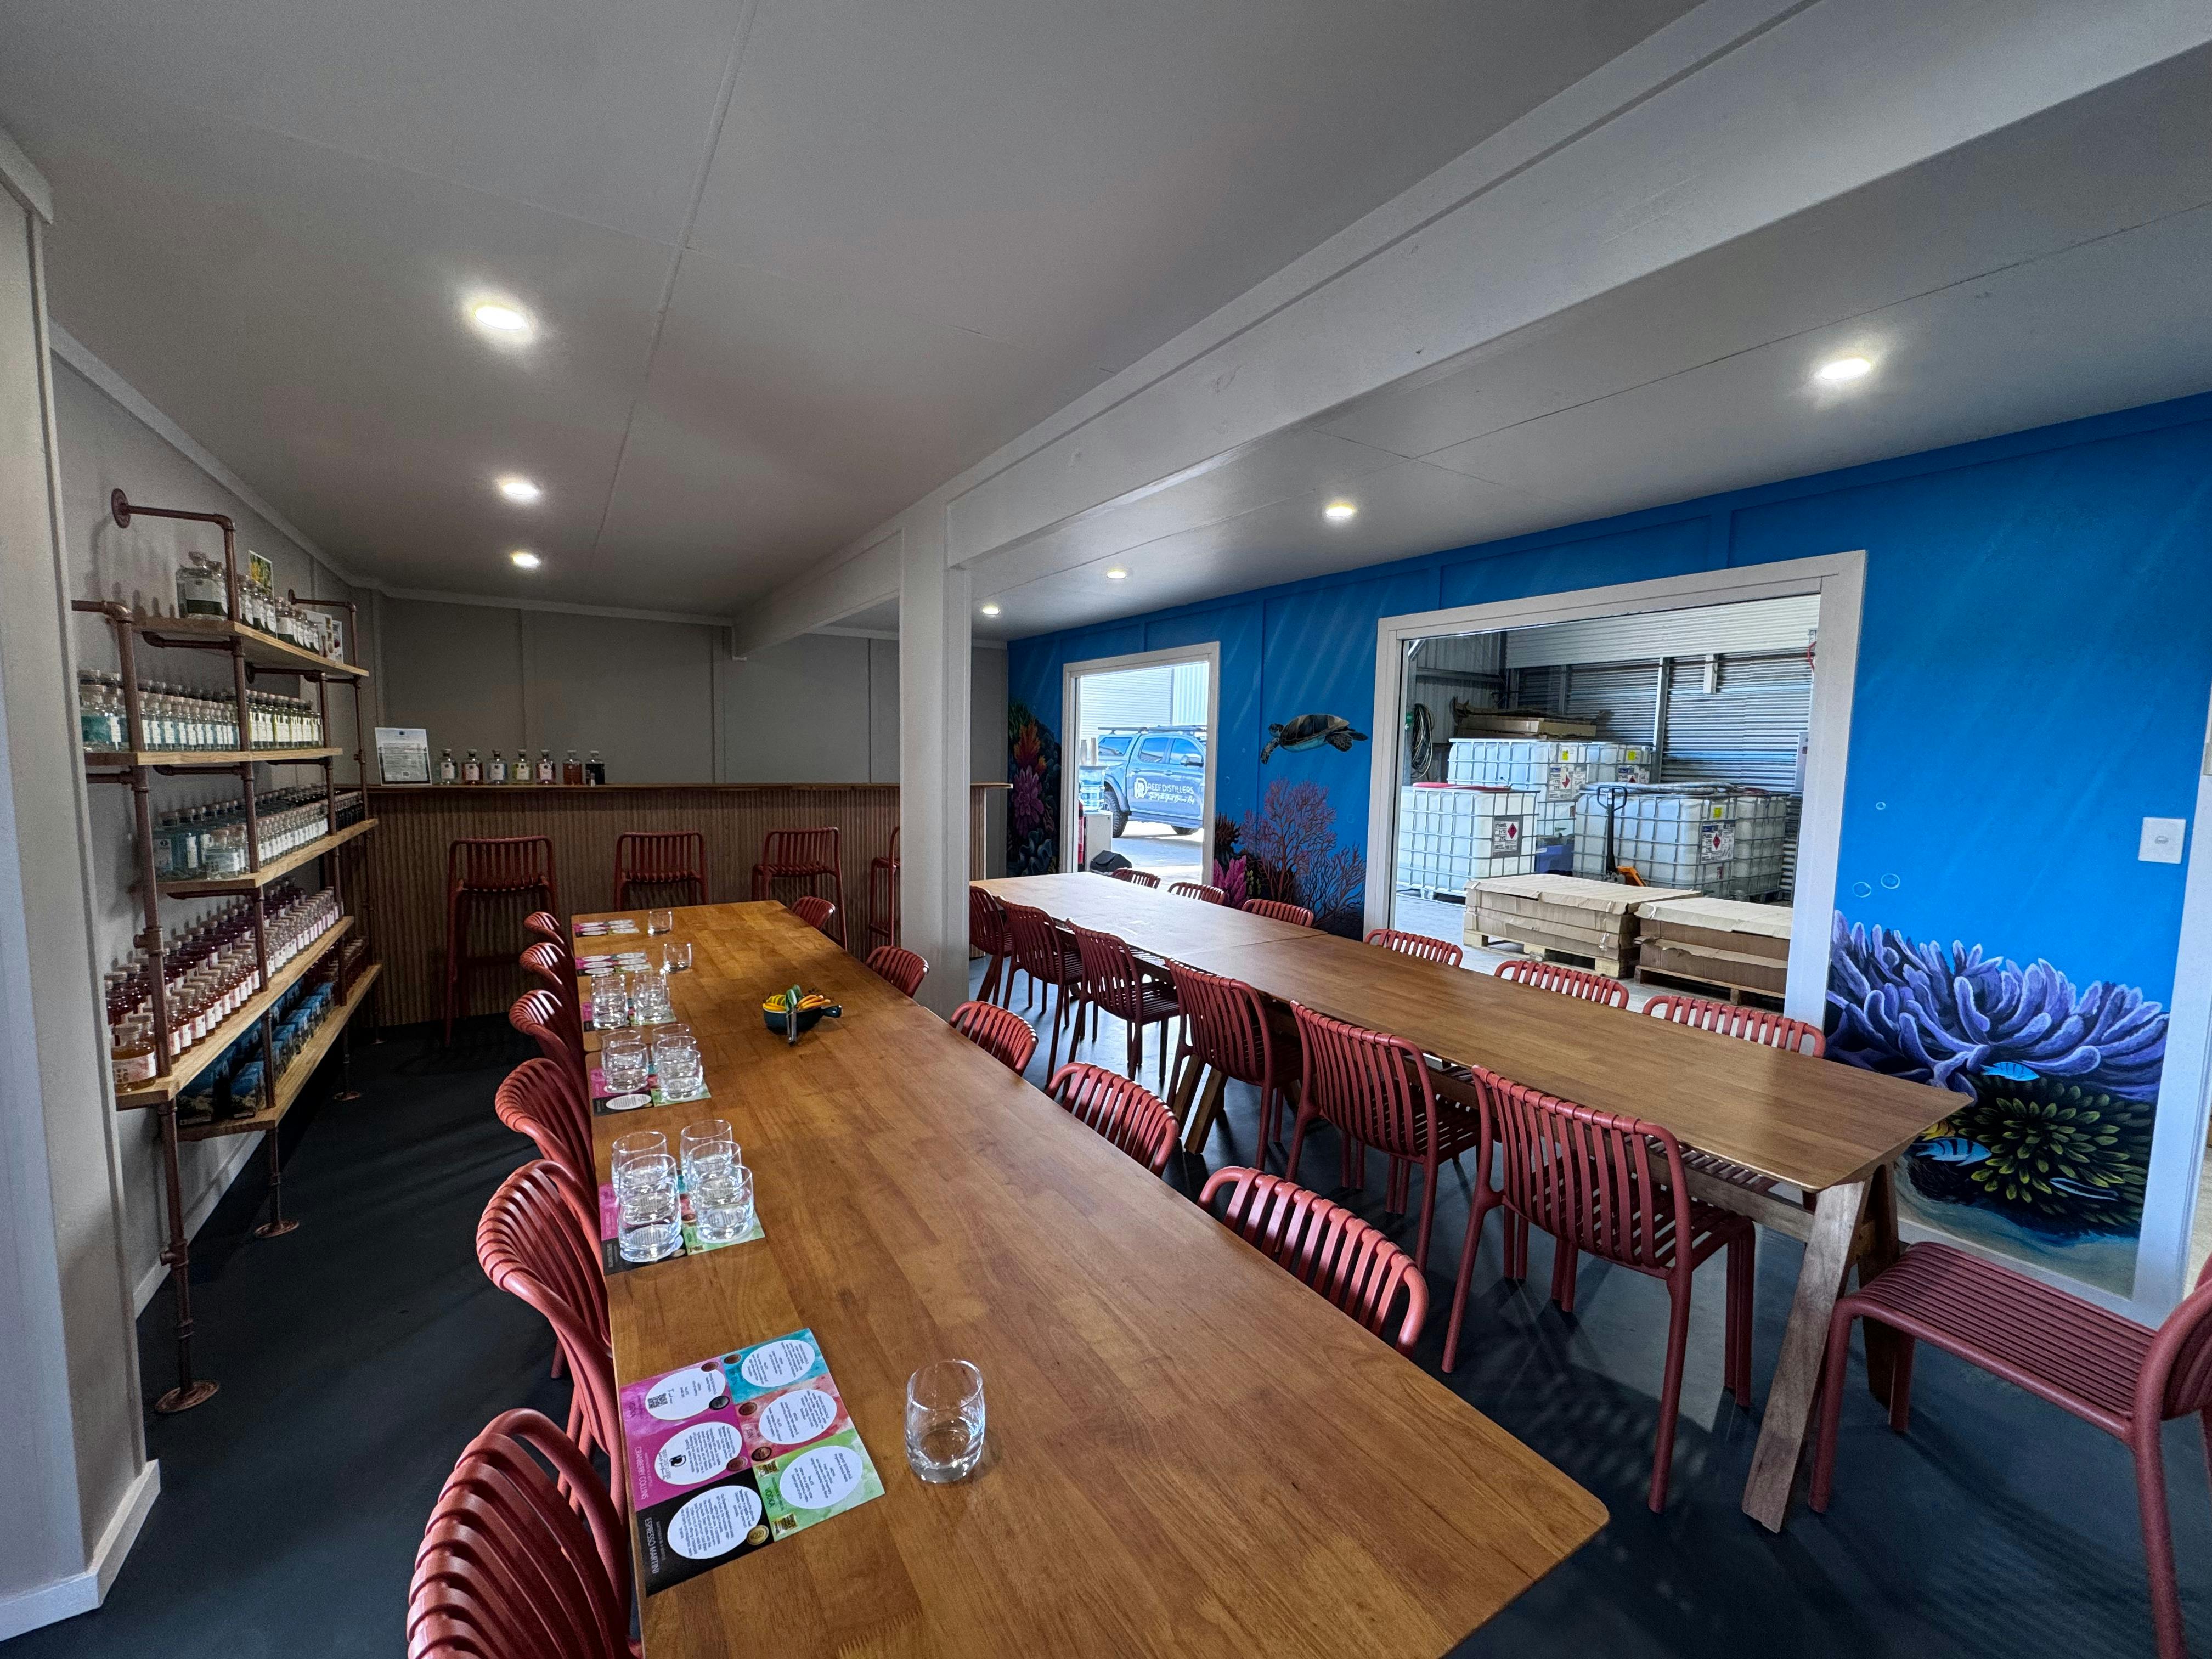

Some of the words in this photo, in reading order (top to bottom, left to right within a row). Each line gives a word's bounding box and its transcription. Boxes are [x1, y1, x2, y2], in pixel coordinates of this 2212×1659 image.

[1148, 783, 1161, 791] REEF
[1162, 785, 1194, 795] DISTILLERS
[635, 1447, 645, 1476] CRANBERRY
[639, 1476, 648, 1499] COLLINS
[764, 1487, 776, 1507] VODKA
[645, 1517, 655, 1547] ESPRESSO
[649, 1546, 659, 1574] MARTINI
